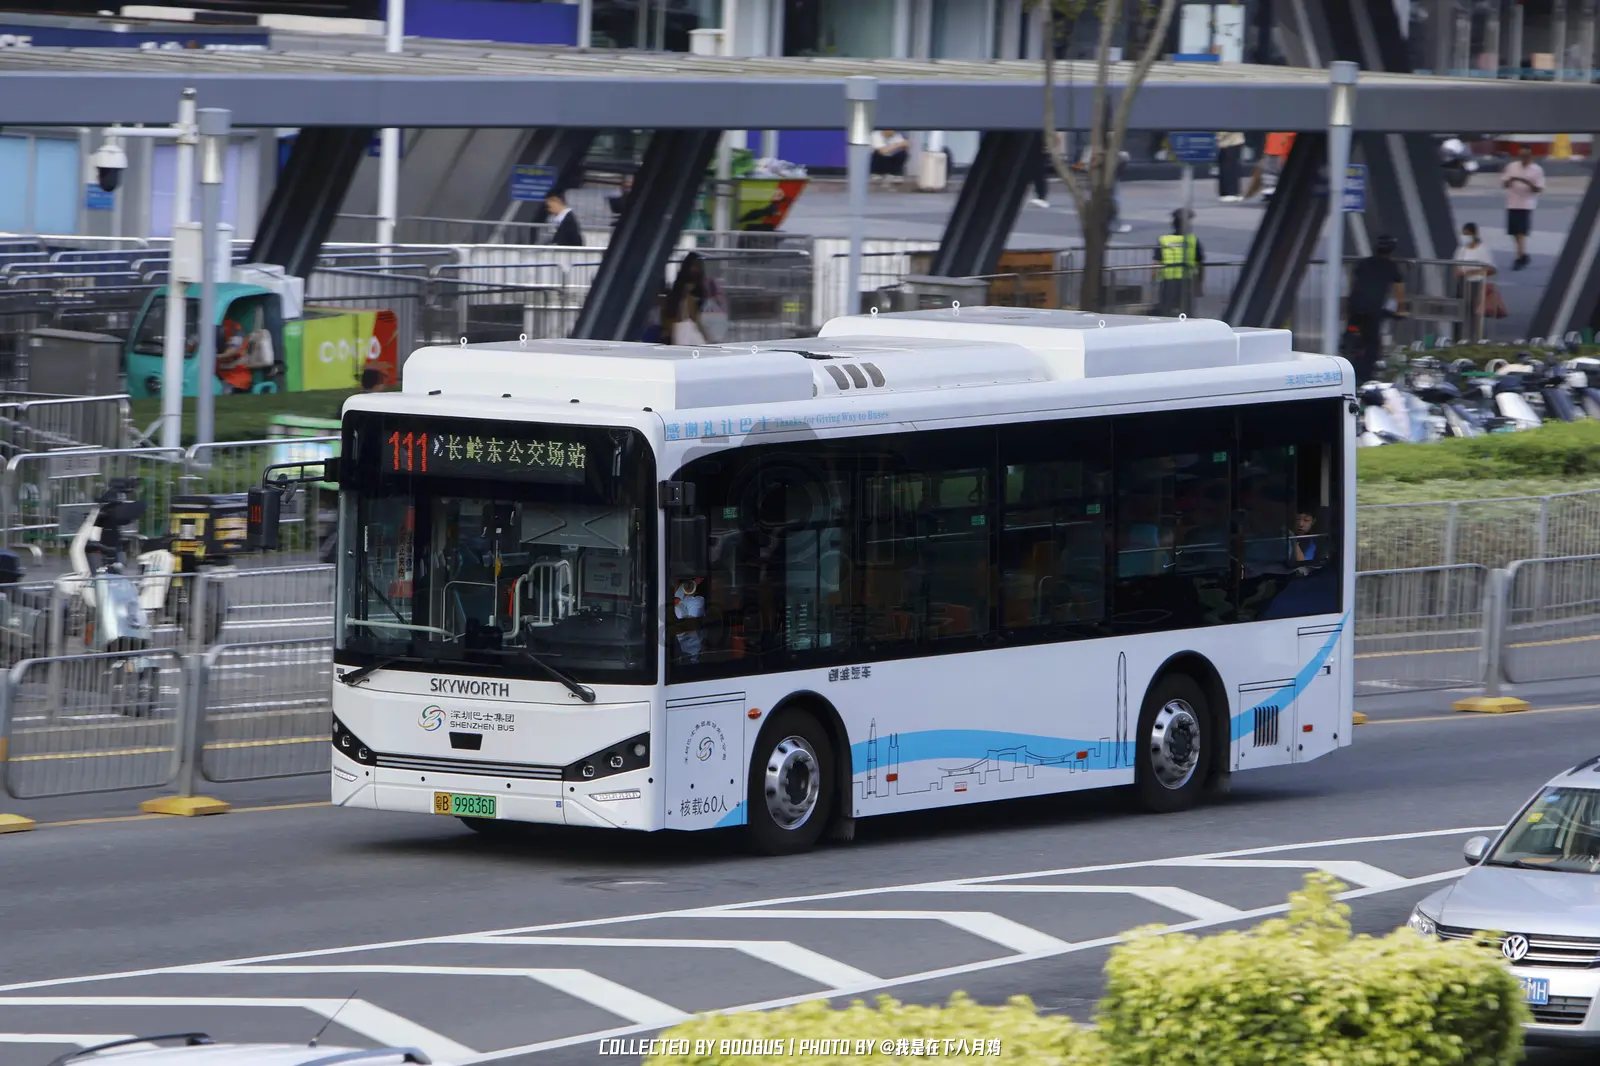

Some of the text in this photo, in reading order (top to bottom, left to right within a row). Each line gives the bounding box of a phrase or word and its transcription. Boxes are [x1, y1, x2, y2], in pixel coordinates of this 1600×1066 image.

[816, 413, 841, 424] Giving
[842, 411, 857, 423] Way
[858, 412, 867, 420] to
[666, 416, 770, 439] 感谢礼让巴士
[388, 431, 428, 472] 111
[445, 434, 587, 469] 长岭东公交场站
[430, 678, 509, 697] SKYWORTH
[450, 710, 515, 723] 深圳巴士集团
[450, 720, 515, 732] SHENZHEN BUS
[454, 797, 494, 814] 99836D
[680, 794, 728, 817] 核载60人
